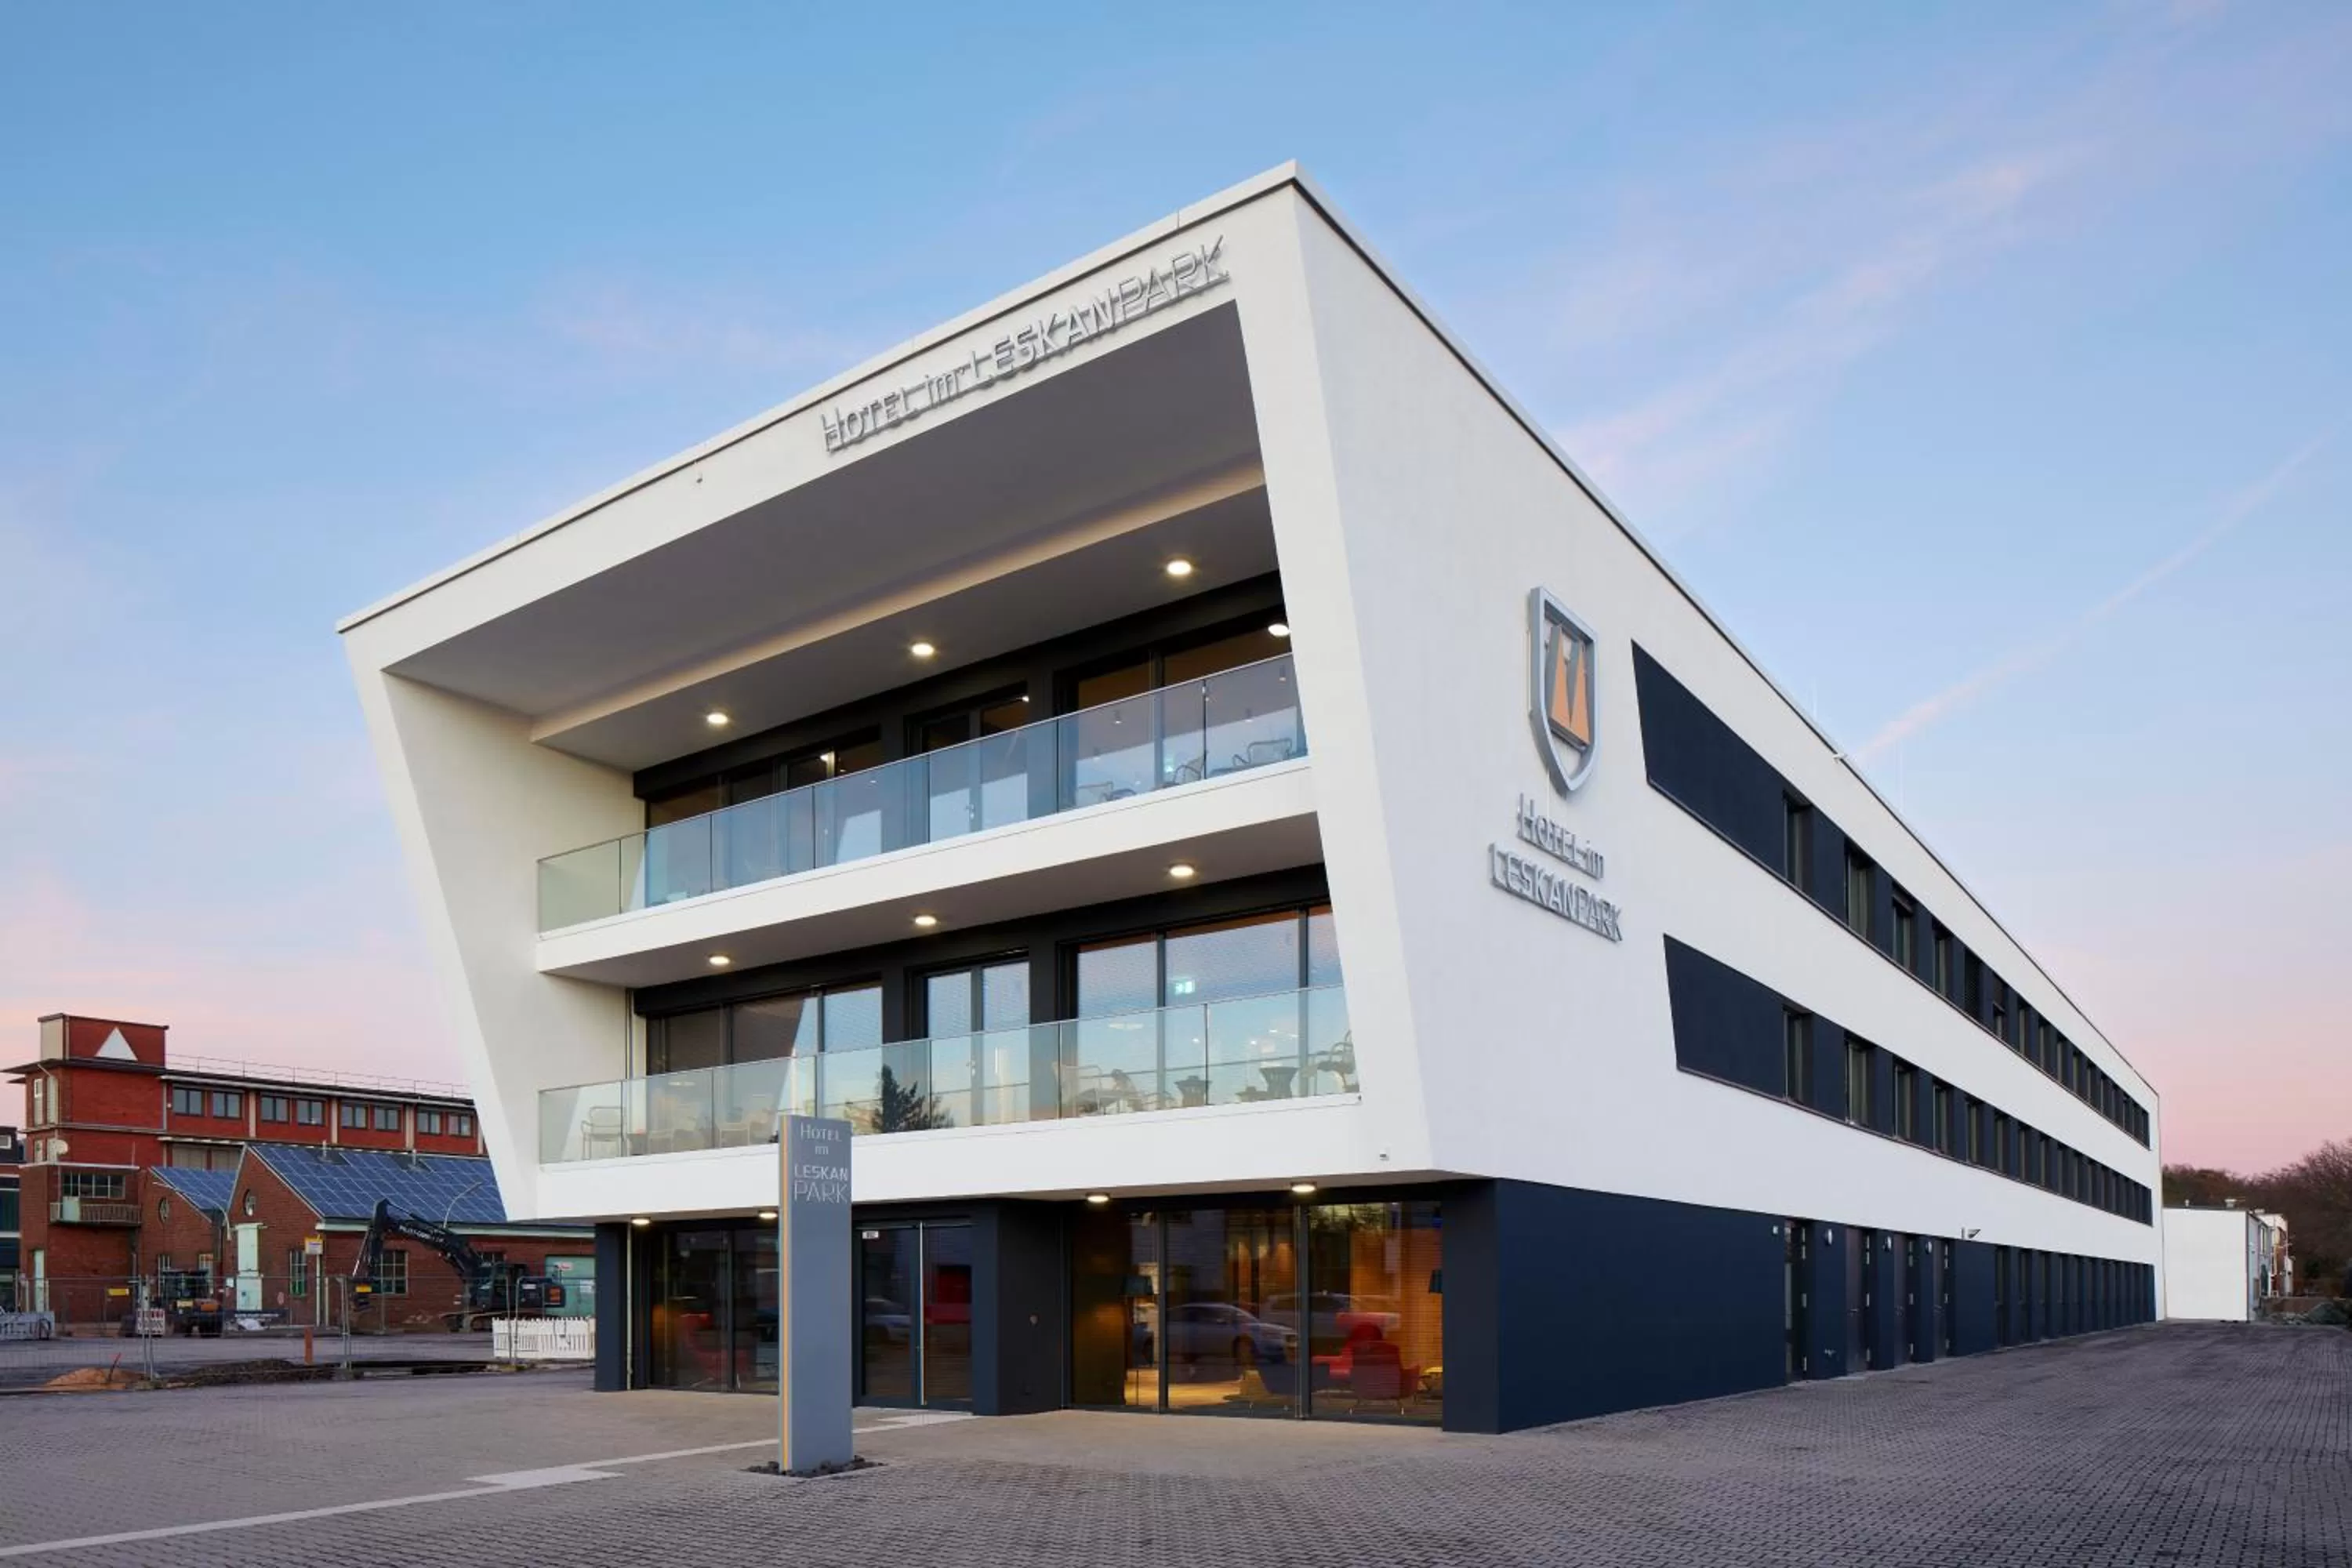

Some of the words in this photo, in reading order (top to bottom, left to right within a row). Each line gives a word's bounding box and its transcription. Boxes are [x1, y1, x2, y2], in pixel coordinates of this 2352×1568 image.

[971, 234, 1230, 379] LESKANPARK
[1489, 842, 1622, 942] LESKANPARK
[794, 1163, 848, 1181] LESKAN
[794, 1180, 847, 1203] PARK
